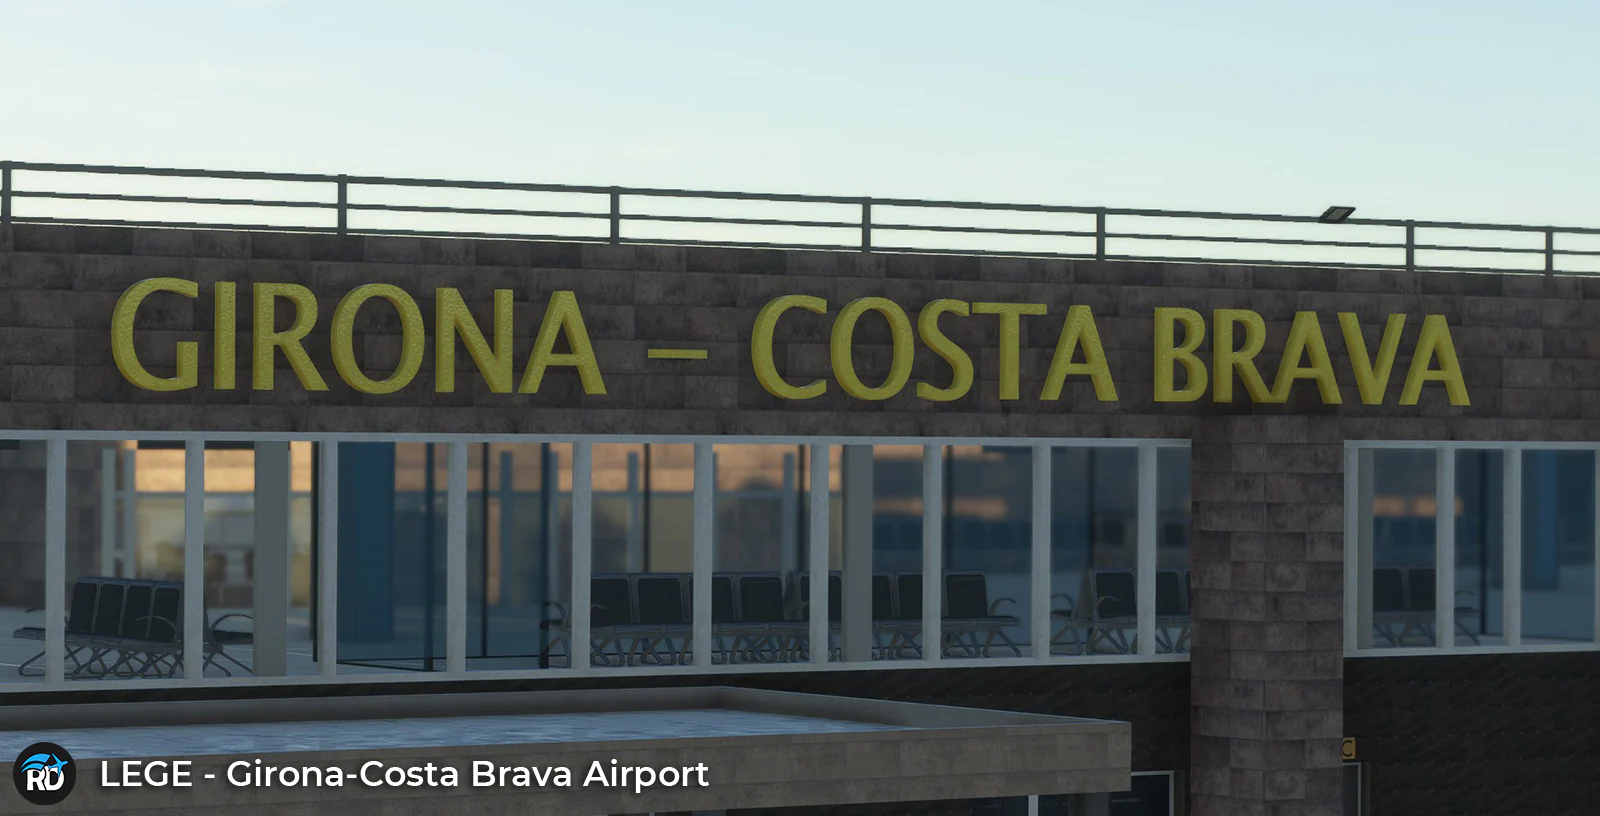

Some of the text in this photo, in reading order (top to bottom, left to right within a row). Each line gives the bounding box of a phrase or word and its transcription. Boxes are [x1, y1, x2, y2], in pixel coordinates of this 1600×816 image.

[110, 277, 607, 395] GIRONA
[751, 294, 1119, 402] COSTA
[1153, 306, 1471, 407] BRAVA
